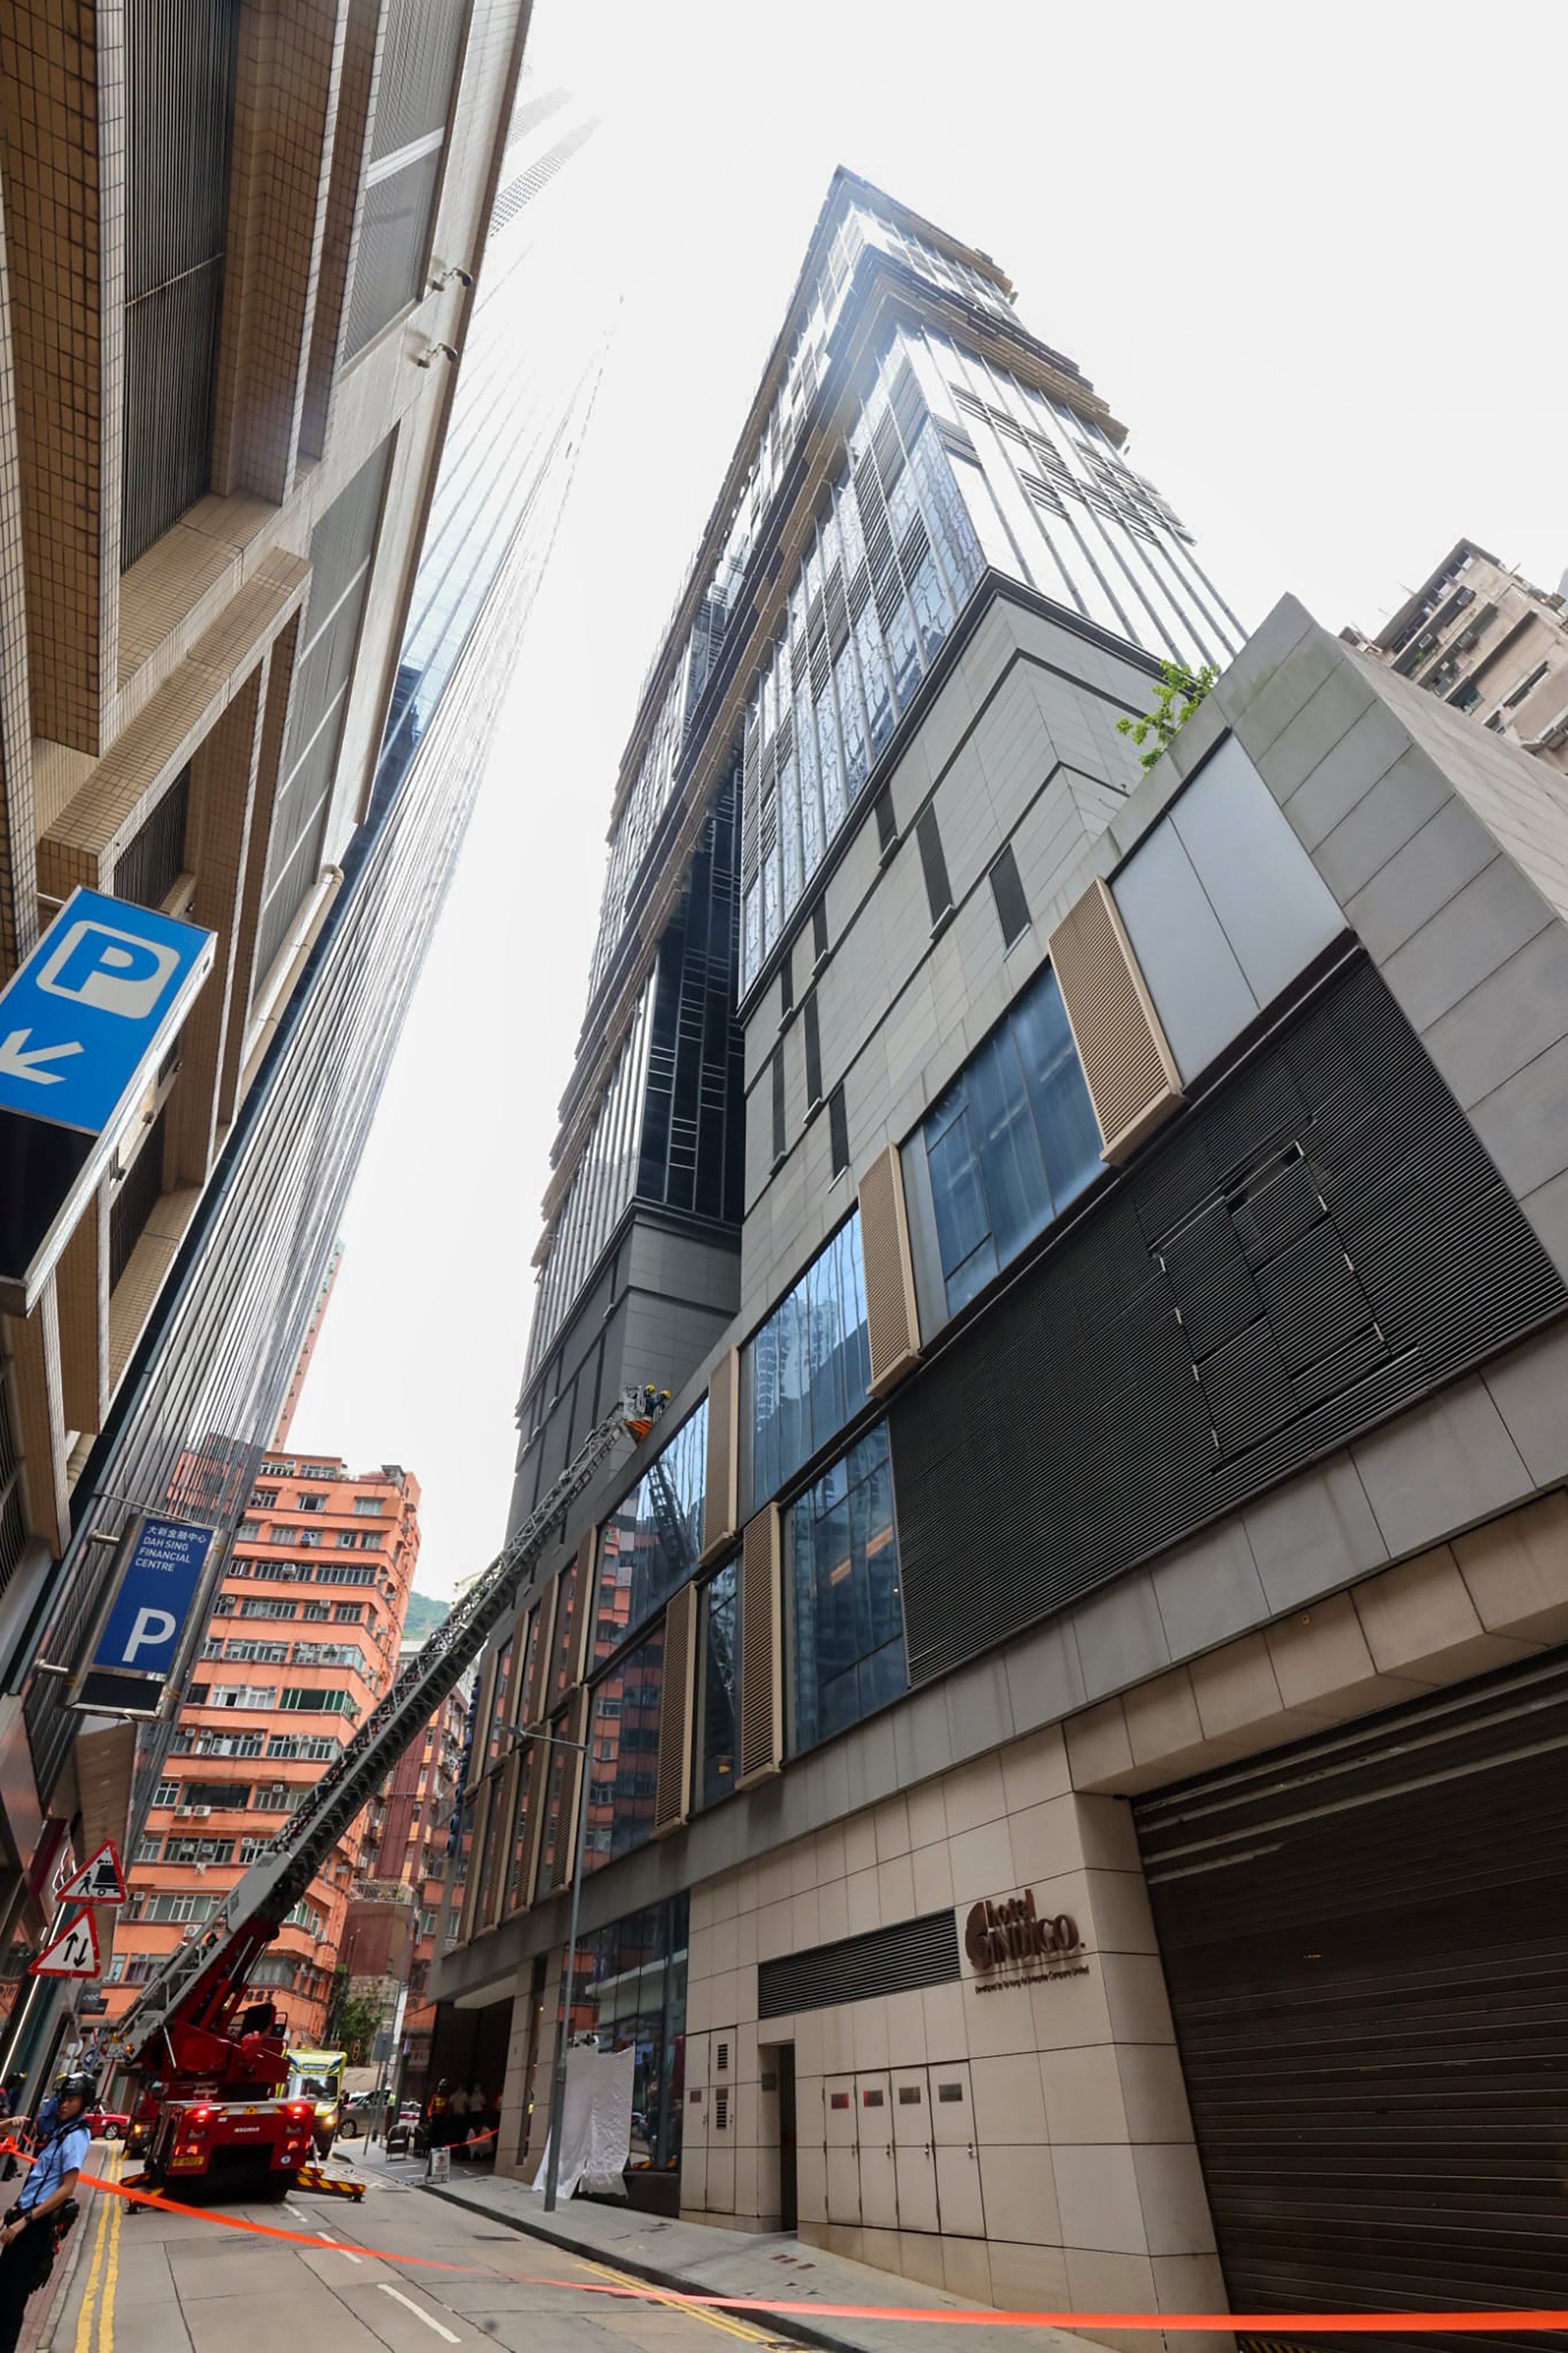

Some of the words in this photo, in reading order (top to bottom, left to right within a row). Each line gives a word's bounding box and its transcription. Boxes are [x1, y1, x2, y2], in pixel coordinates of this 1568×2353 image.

[51, 928, 159, 993] P
[144, 1537, 164, 1547] DAH
[165, 1540, 189, 1551] SING
[147, 1525, 207, 1544] 大新金融中心
[139, 1547, 191, 1563] FINANCIAL
[135, 1558, 175, 1572] CENTRE
[122, 1607, 176, 1663] P
[985, 1889, 1037, 1928] hotel
